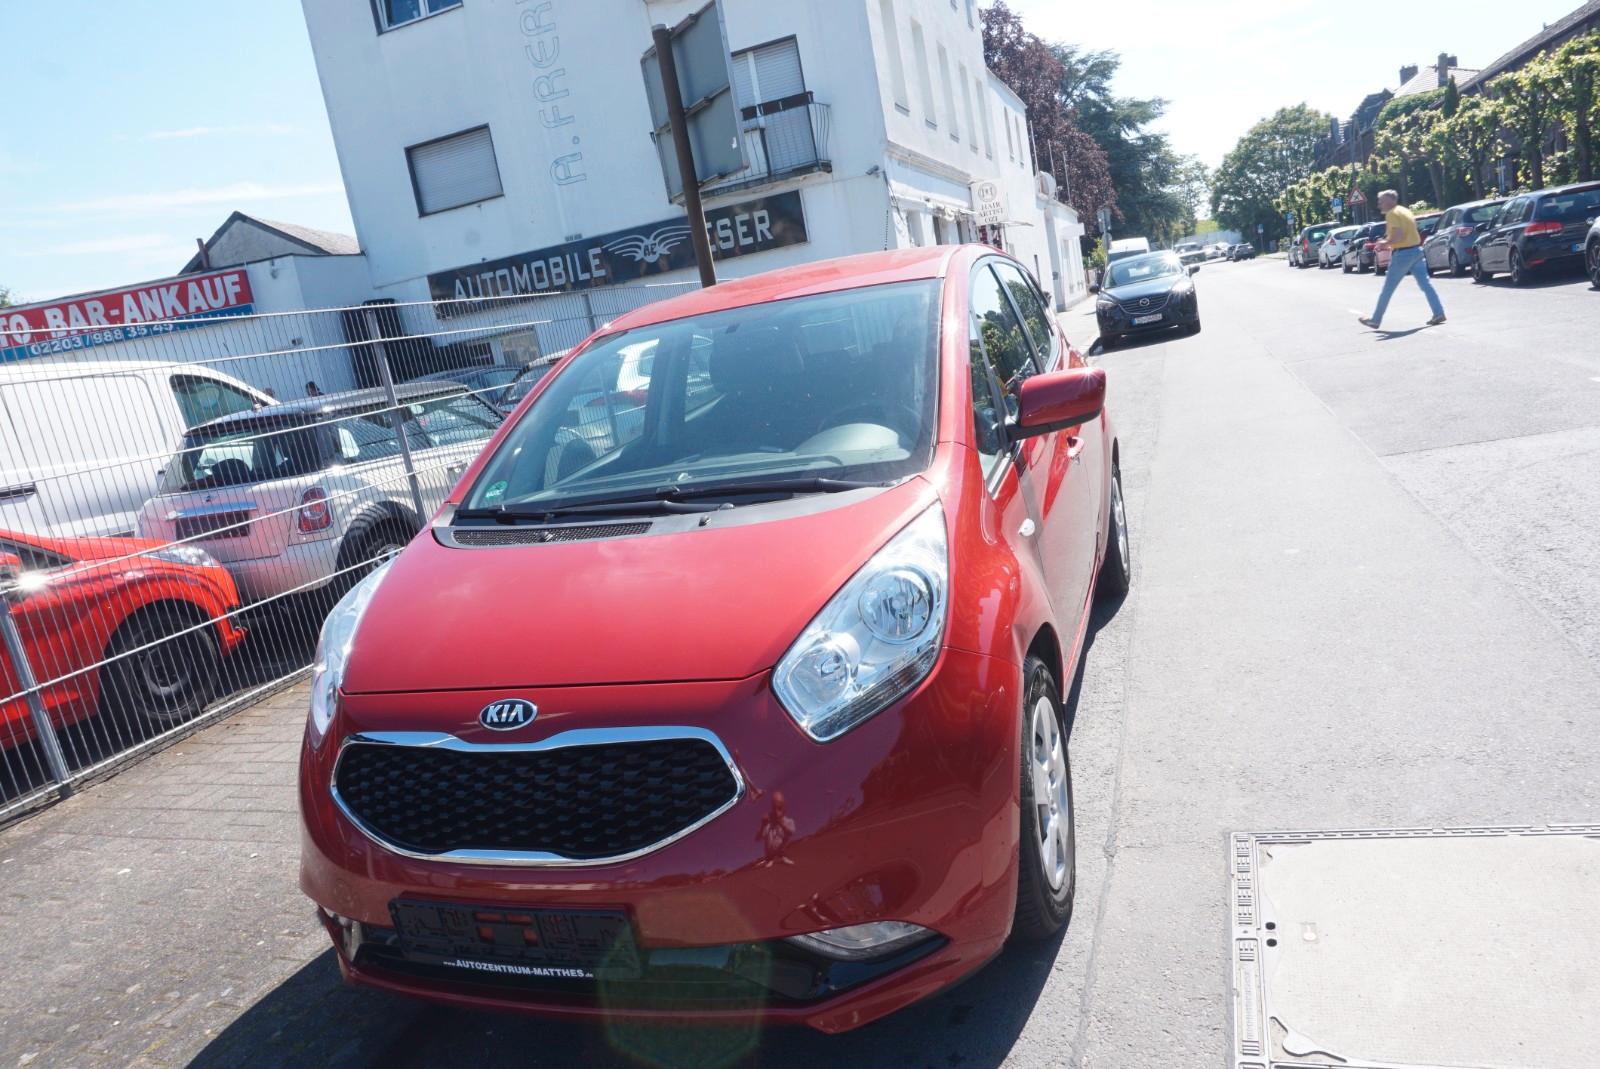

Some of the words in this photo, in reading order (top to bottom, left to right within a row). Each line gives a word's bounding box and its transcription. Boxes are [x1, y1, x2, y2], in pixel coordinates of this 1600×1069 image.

[454, 247, 607, 303] AUTOMOBILE
[44, 274, 241, 338] BAR-ANKAUF
[486, 703, 524, 723] KIA
